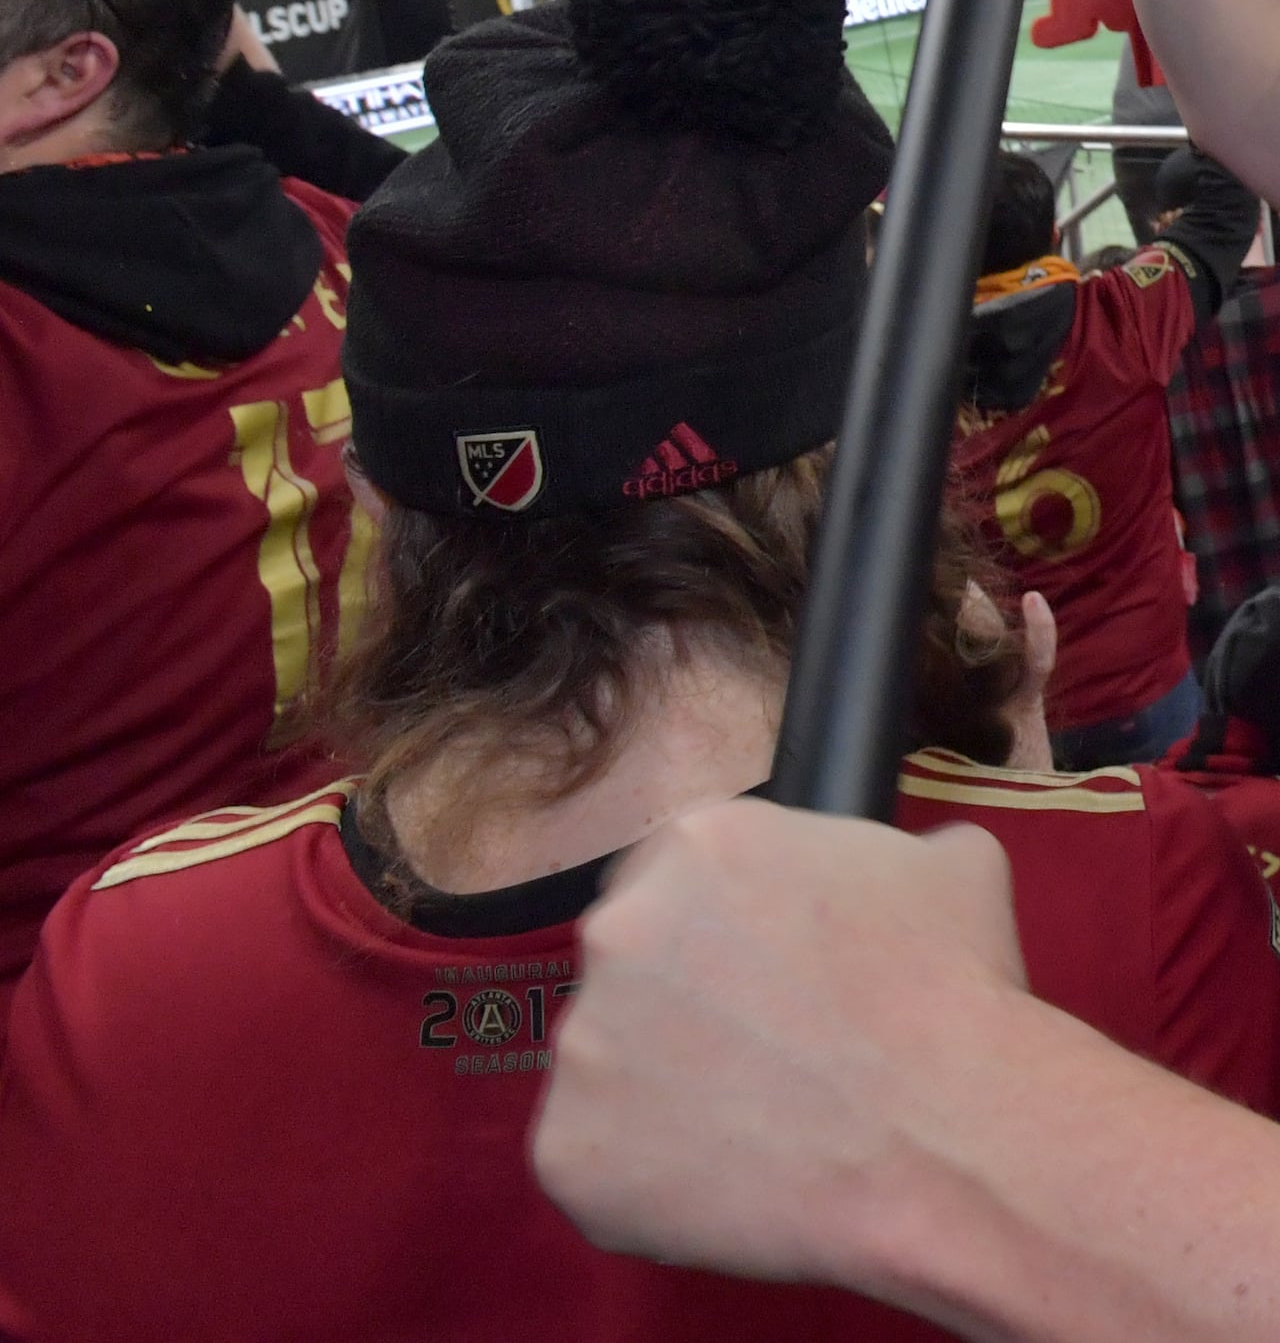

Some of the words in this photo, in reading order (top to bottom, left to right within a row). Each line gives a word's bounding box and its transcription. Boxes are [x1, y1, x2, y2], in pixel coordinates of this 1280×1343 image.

[467, 442, 506, 460] MLS
[621, 459, 738, 499] adidas
[455, 1049, 553, 1076] SEASON
